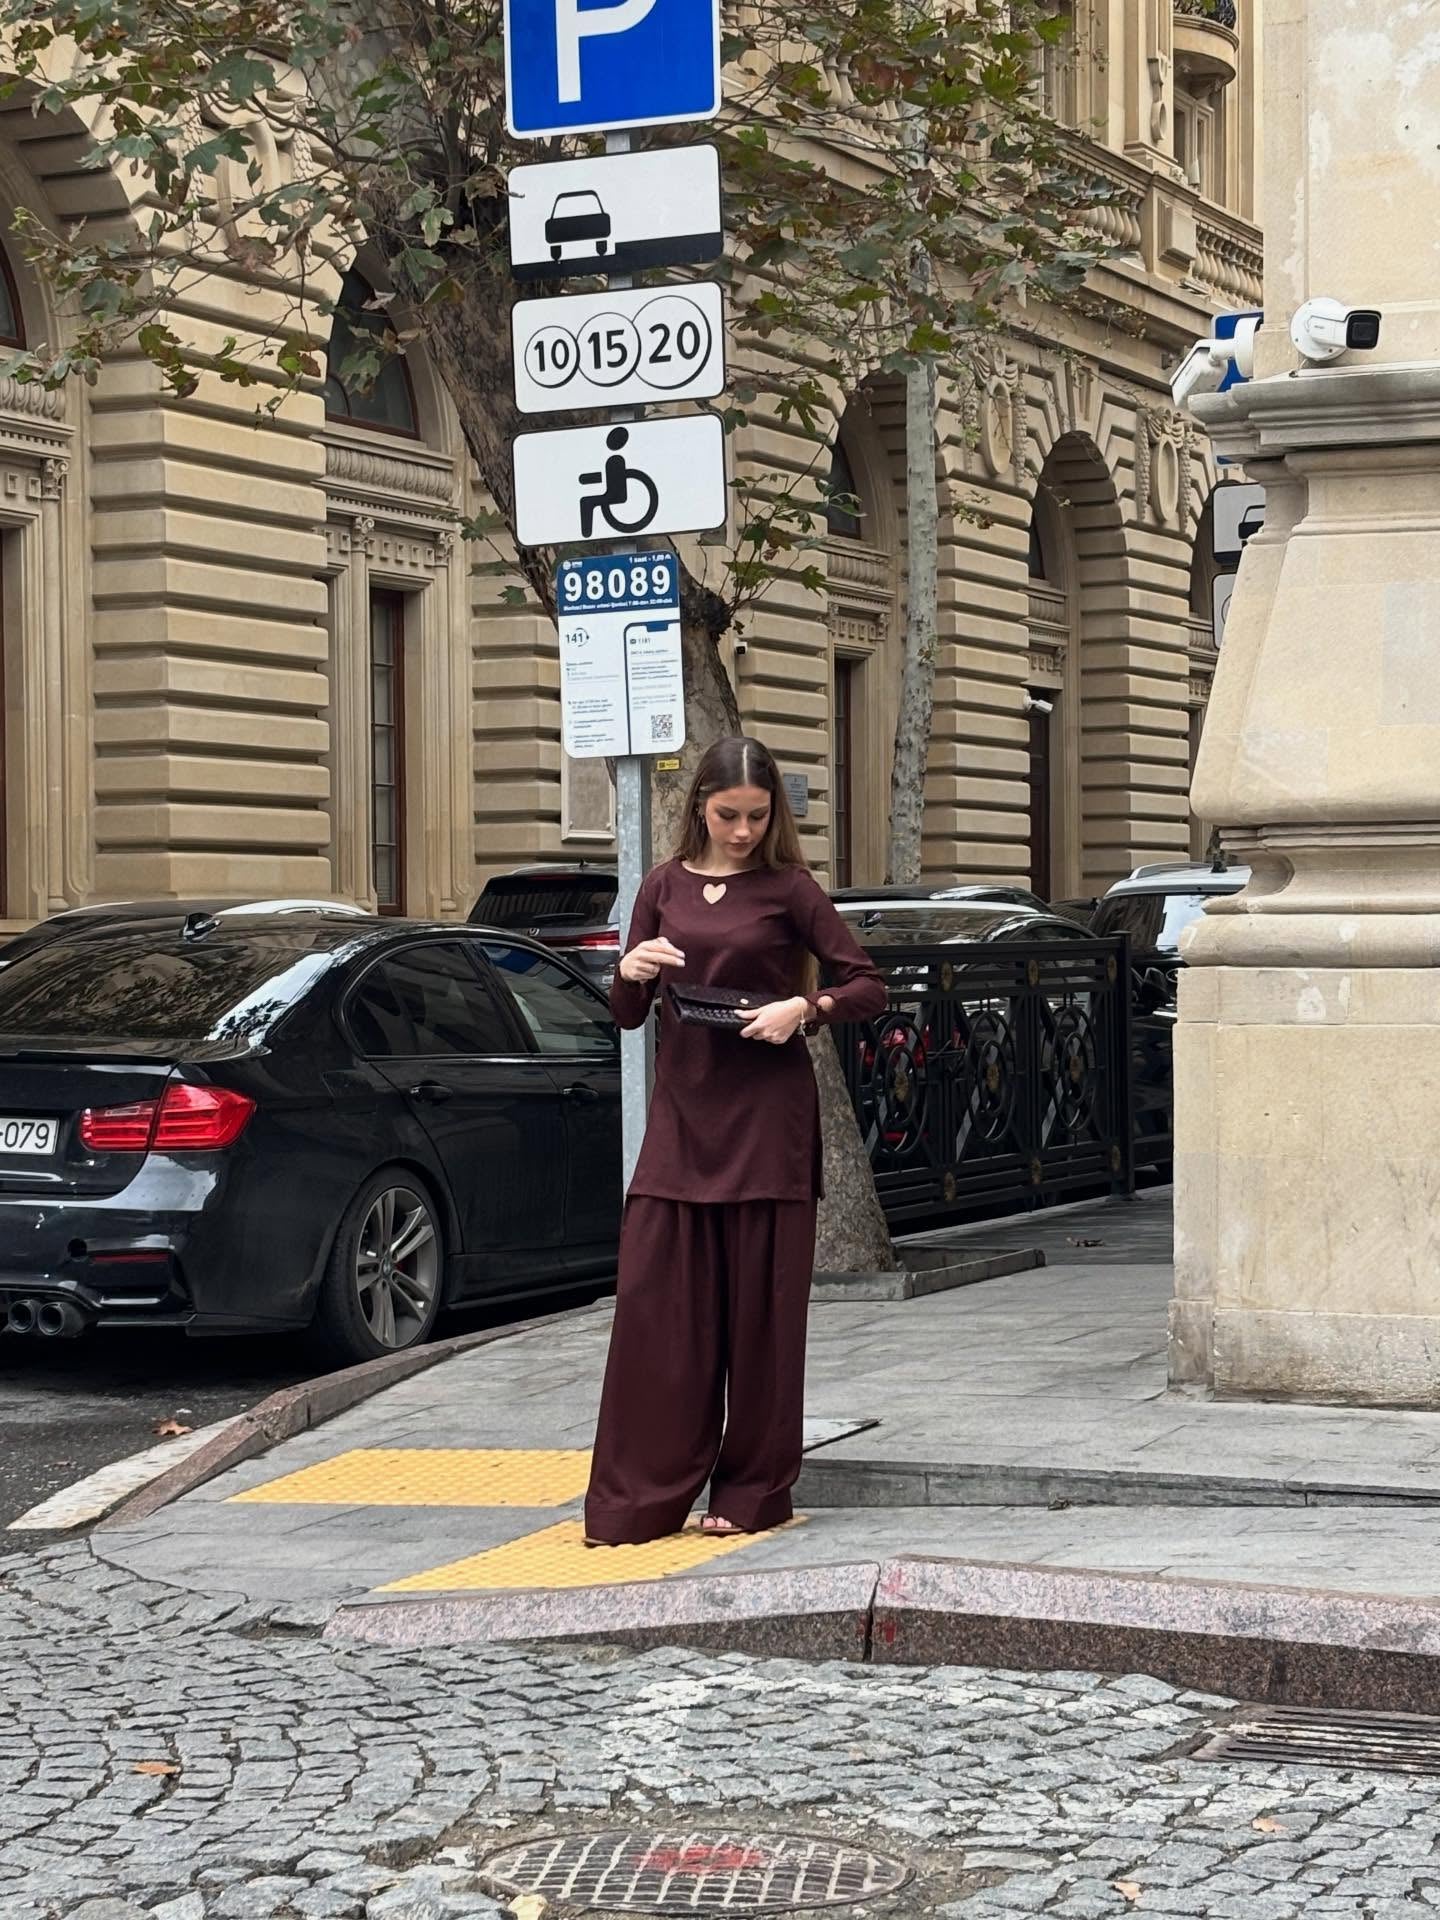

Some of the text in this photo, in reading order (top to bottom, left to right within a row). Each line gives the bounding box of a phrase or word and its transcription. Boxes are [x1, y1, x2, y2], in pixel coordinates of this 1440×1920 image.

[555, 0, 657, 104] P
[534, 320, 701, 372] 10 15 20
[563, 565, 671, 602] 98089
[565, 632, 583, 644] 141
